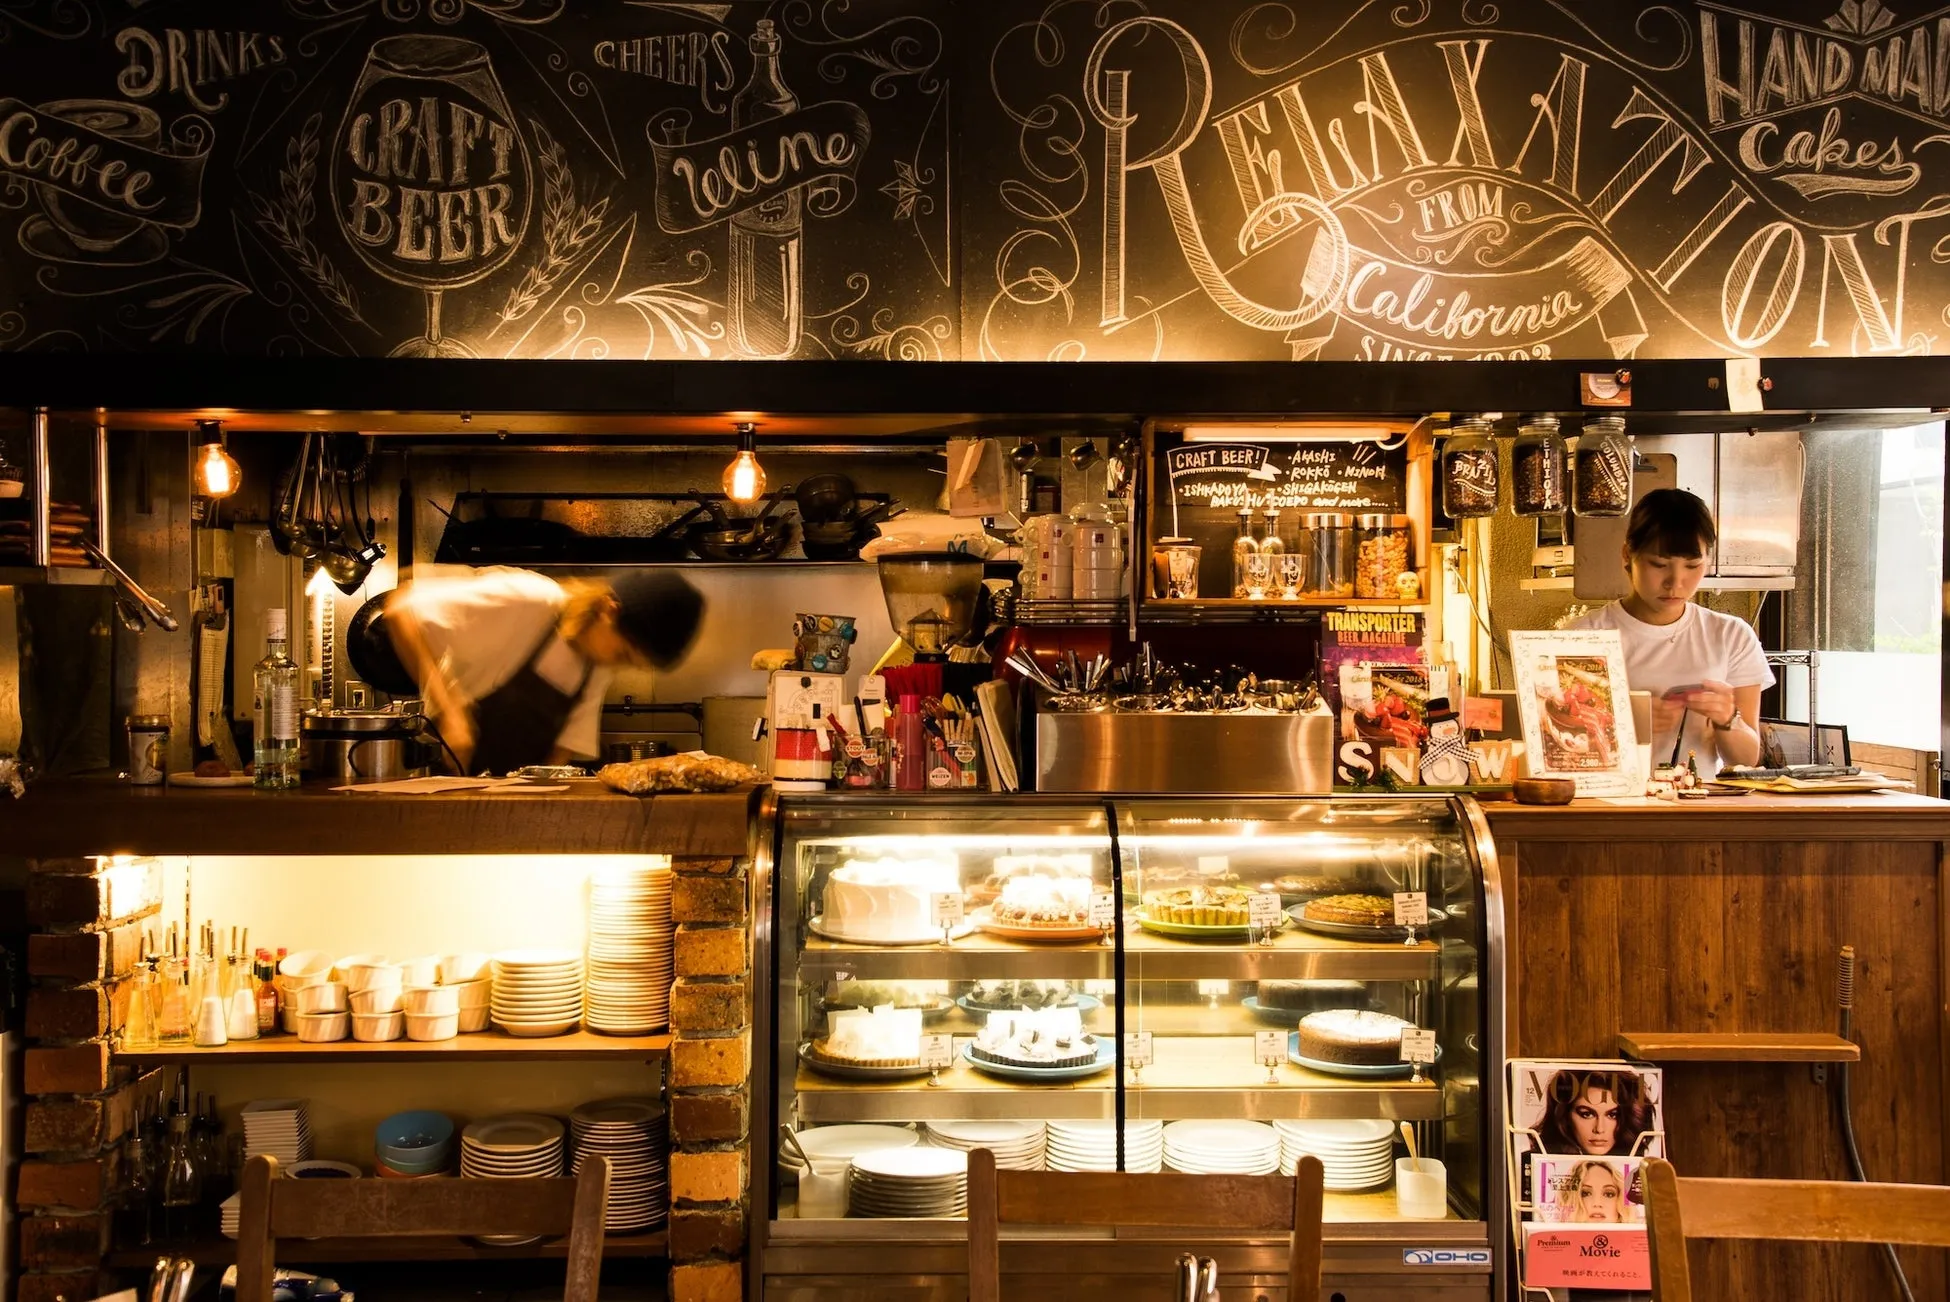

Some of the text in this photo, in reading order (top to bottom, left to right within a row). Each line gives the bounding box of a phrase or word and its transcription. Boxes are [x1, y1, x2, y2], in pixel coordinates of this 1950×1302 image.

[594, 31, 734, 114] CHEERS
[0, 112, 166, 212] Coffee
[349, 97, 515, 184] CRAFT
[1738, 107, 1920, 176] Cakes
[672, 130, 856, 218] Wine
[350, 178, 518, 263] BEER
[1415, 183, 1504, 233] FROM
[1346, 261, 1583, 341] California
[1176, 449, 1260, 469] CRAFT BEER!
[1291, 449, 1336, 465] AKASHI
[1452, 458, 1496, 486] BRAZIL
[1600, 441, 1628, 490] COLUMBIA
[1312, 496, 1340, 507] and
[1326, 612, 1416, 633] TRANSPORTER
[1337, 631, 1406, 644] BEER MAGAZINE
[1537, 1239, 1571, 1247] Premium
[1579, 1246, 1621, 1257] Movie
